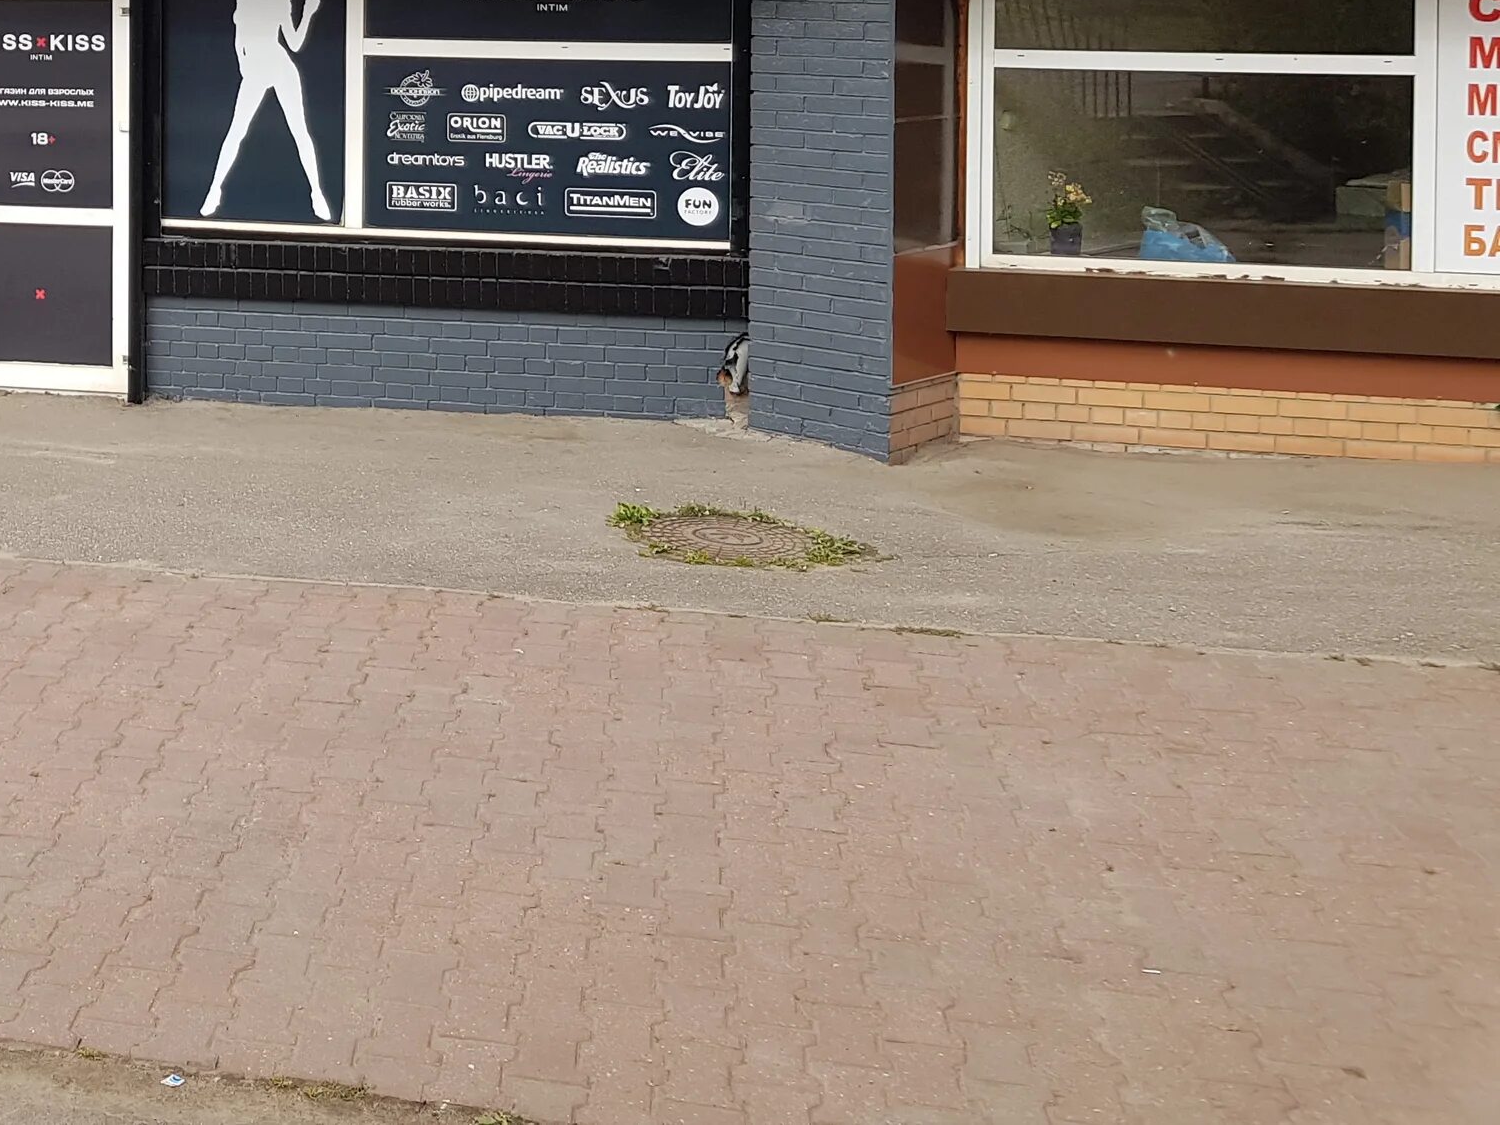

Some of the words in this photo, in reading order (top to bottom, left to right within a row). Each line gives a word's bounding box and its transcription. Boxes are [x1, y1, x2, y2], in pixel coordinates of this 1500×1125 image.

[536, 3, 568, 12] INTIM
[28, 87, 46, 96] ДЛЯ
[47, 88, 95, 96] ВЗРОСЛЫХ
[479, 83, 562, 102] pipedream
[386, 119, 426, 137] Exotic
[450, 116, 502, 133] ORION
[30, 132, 56, 145] 18+
[386, 151, 465, 167] dreamtoys
[576, 156, 651, 177] Realistics
[669, 150, 725, 181] Elite
[9, 171, 36, 183] VISA
[506, 166, 553, 185] Lingerie
[391, 184, 452, 200] BASIX
[391, 198, 421, 207] rubber
[684, 198, 712, 209] FUN
